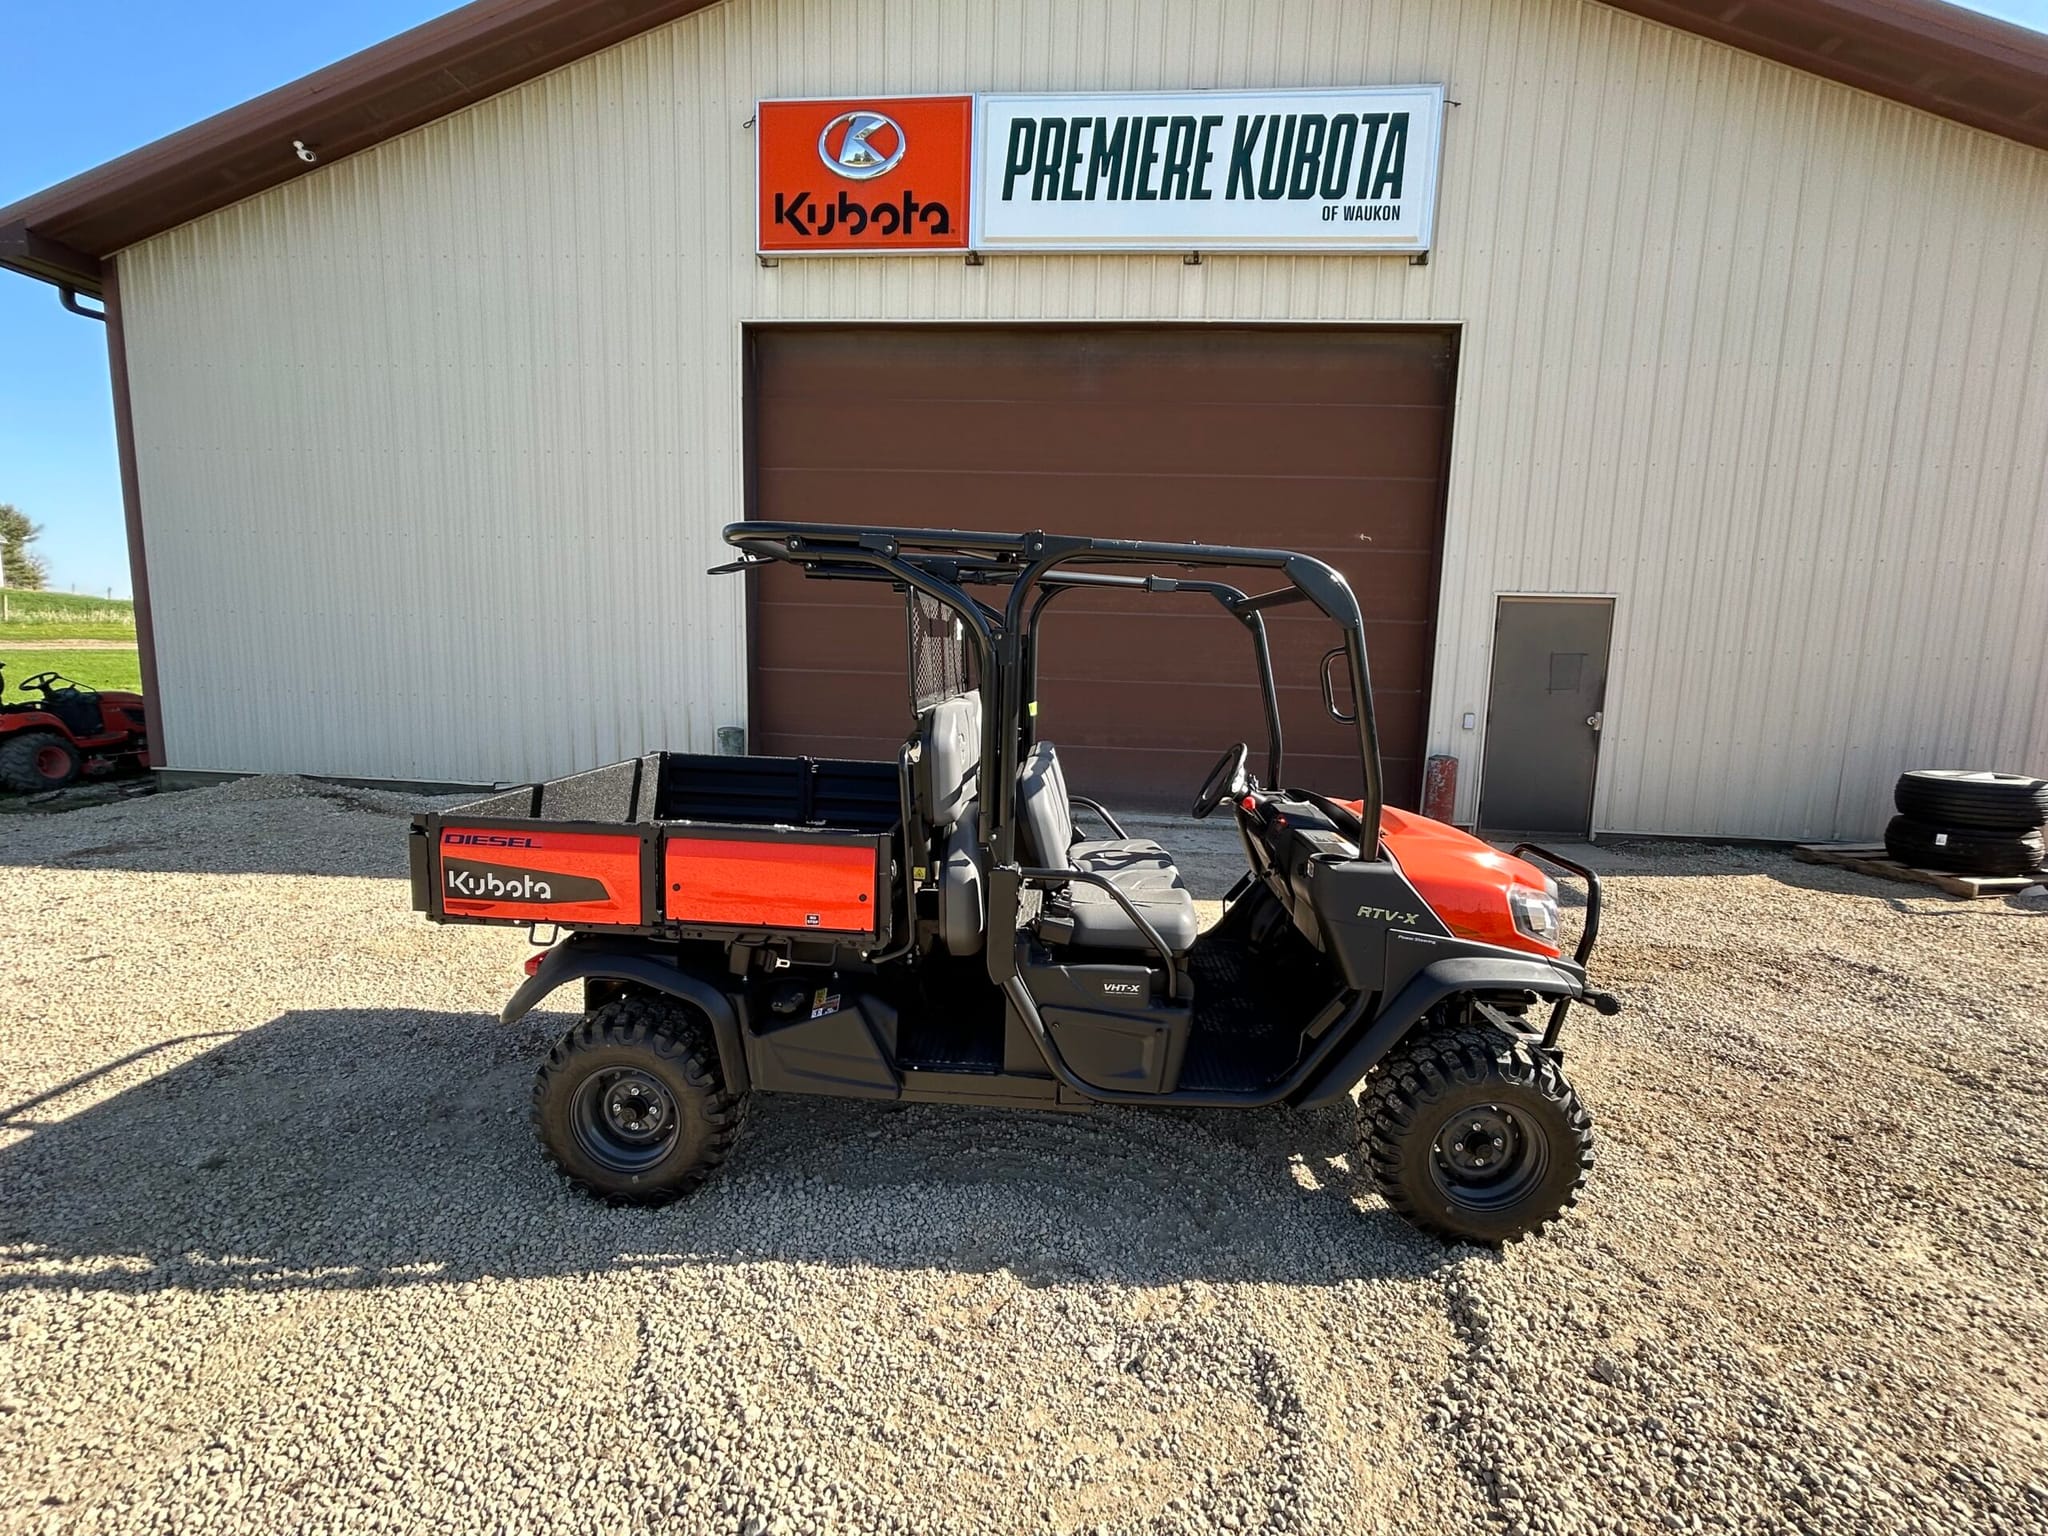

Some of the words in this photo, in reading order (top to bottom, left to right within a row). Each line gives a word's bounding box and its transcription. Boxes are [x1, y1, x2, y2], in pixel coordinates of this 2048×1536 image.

[1001, 114, 1224, 201] PREMIERE
[1225, 112, 1410, 200] KUBOTA
[774, 190, 950, 236] Kubota
[1321, 204, 1339, 222] OF
[1342, 204, 1401, 222] WAUKON
[444, 833, 543, 849] DIESEL
[448, 870, 552, 900] Kubota
[1356, 905, 1420, 925] RTV-X
[1103, 983, 1141, 992] VHT-X
